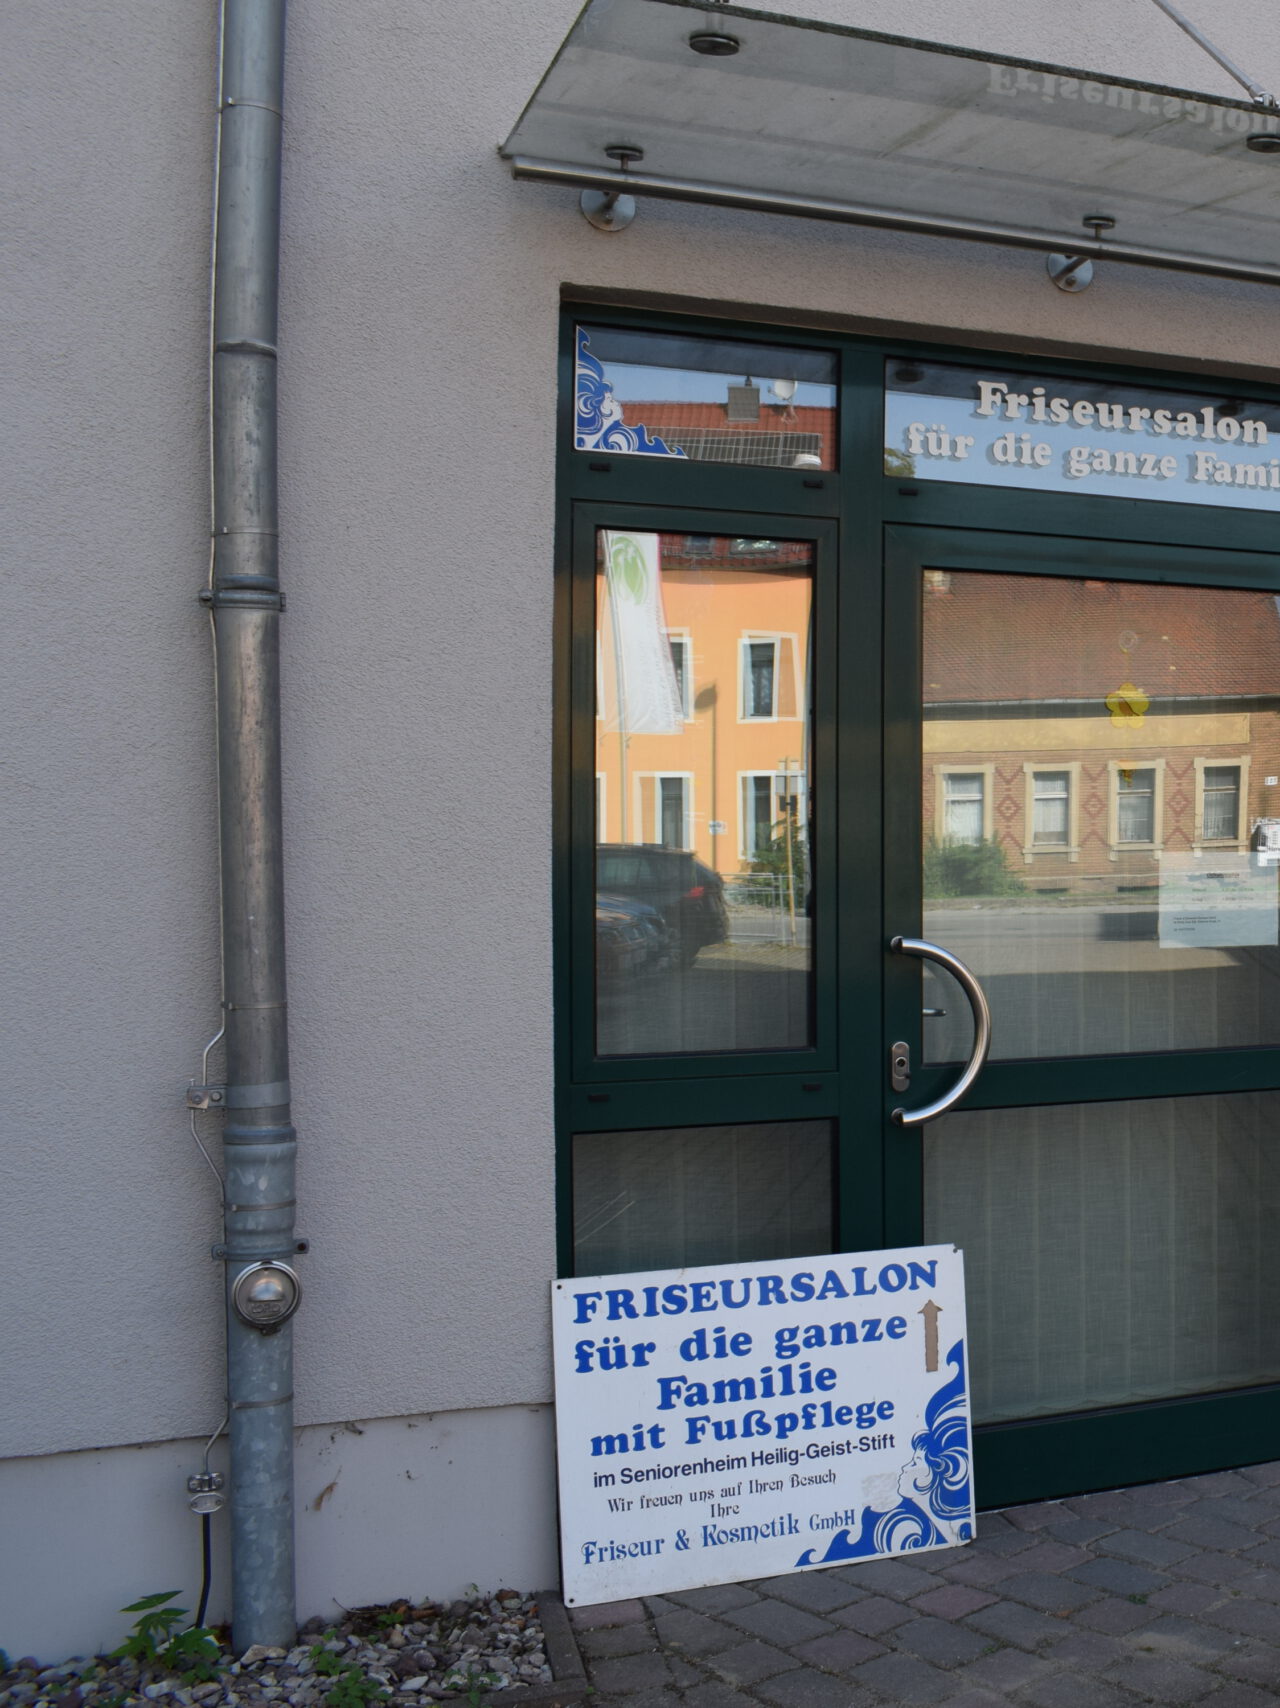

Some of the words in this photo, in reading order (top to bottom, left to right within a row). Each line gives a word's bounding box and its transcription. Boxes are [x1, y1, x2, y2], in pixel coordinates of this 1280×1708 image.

[975, 380, 1269, 446] Friseursalon
[906, 423, 975, 460] für
[992, 432, 1053, 467] die
[1067, 447, 1178, 479] ganze
[572, 1259, 938, 1325] FRISEURSALON
[574, 1336, 656, 1374] für
[680, 1326, 753, 1363] die
[774, 1315, 908, 1359] ganze
[656, 1362, 838, 1411] Familie
[590, 1423, 666, 1457] mit
[684, 1400, 895, 1445] Fußpflege
[593, 1470, 616, 1489] im
[620, 1454, 748, 1485] Seniorenheim
[750, 1433, 896, 1471] Heilig-Geist-Stift
[607, 1497, 634, 1514] Wir
[639, 1492, 684, 1511] freuen
[688, 1489, 715, 1505] uns
[719, 1481, 743, 1499] auf
[748, 1477, 785, 1496] Ihren
[788, 1470, 837, 1489] Besuch
[708, 1502, 741, 1519] Ihre
[580, 1536, 666, 1565] Friseur
[674, 1528, 691, 1551] &
[701, 1513, 801, 1550] Kosmetik
[808, 1508, 857, 1532] GmbH
